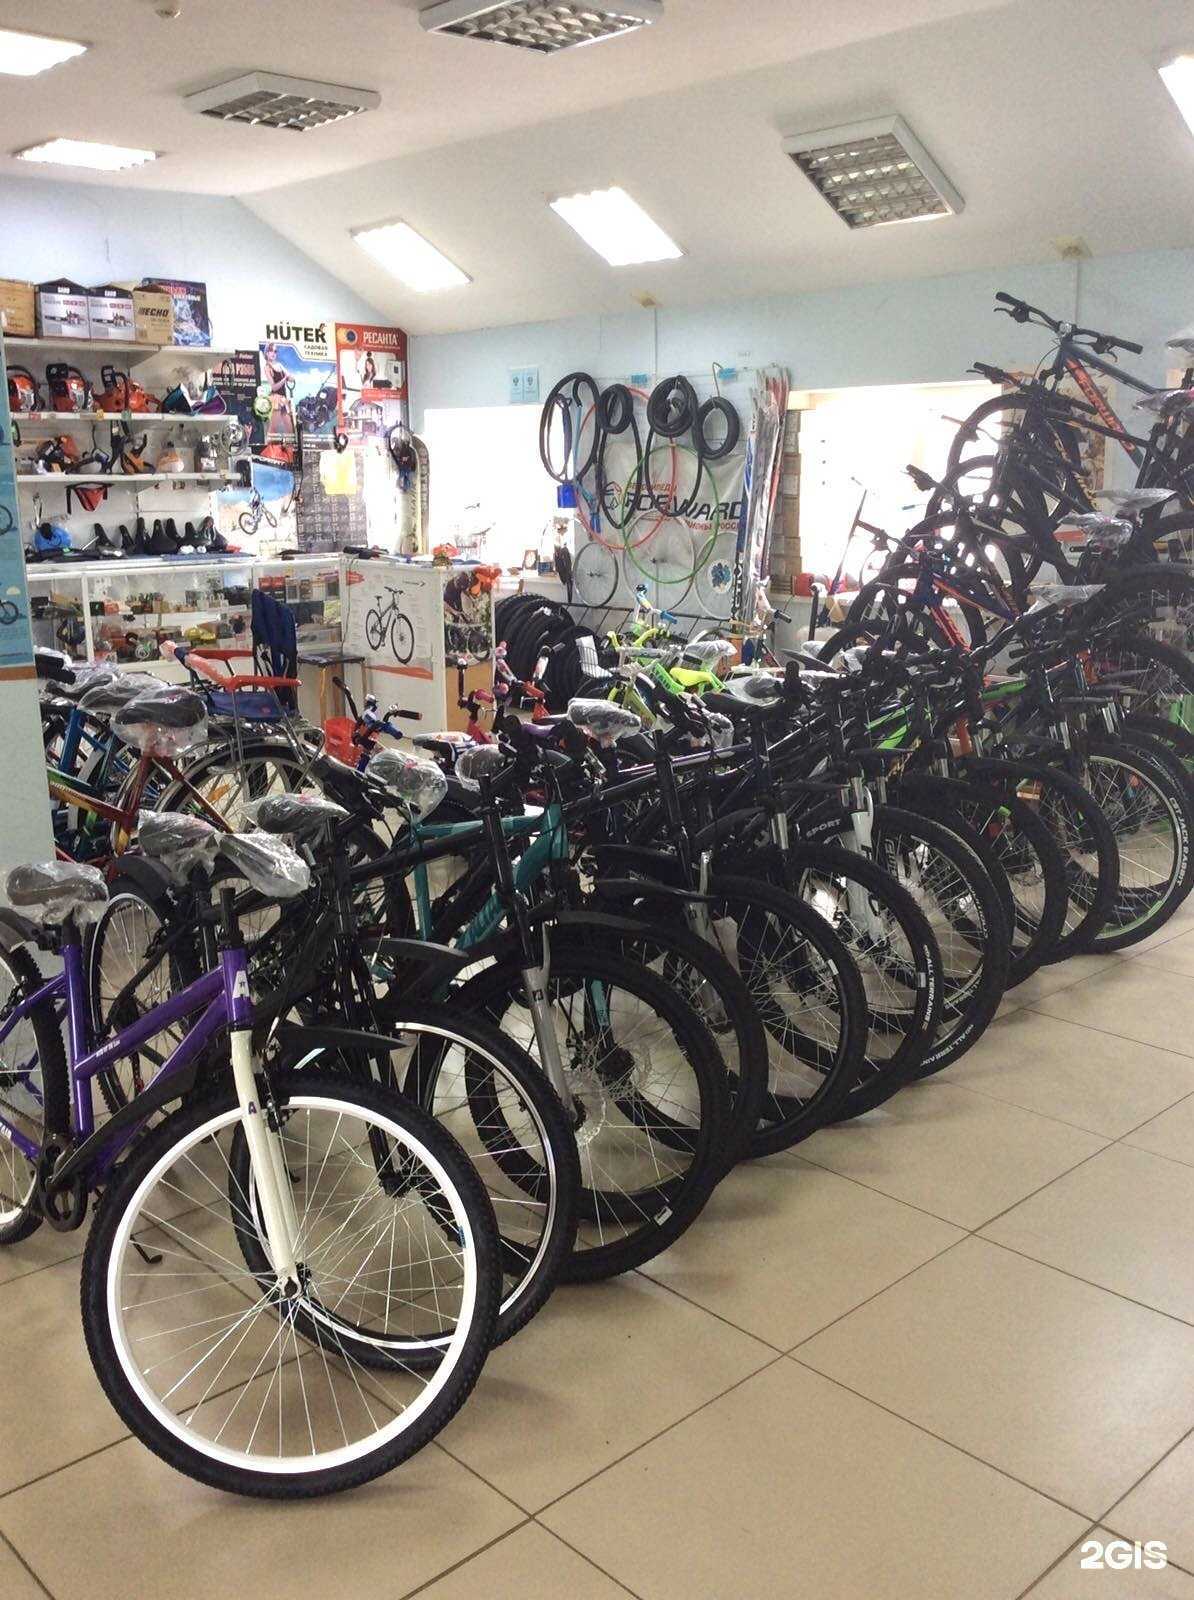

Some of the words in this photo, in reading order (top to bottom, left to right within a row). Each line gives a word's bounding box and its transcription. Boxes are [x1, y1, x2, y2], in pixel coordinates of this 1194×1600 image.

[144, 308, 169, 317] ECHO
[363, 331, 397, 345] РЕСАНТА
[806, 819, 841, 837] SPORT
[1178, 817, 1189, 844] JACK
